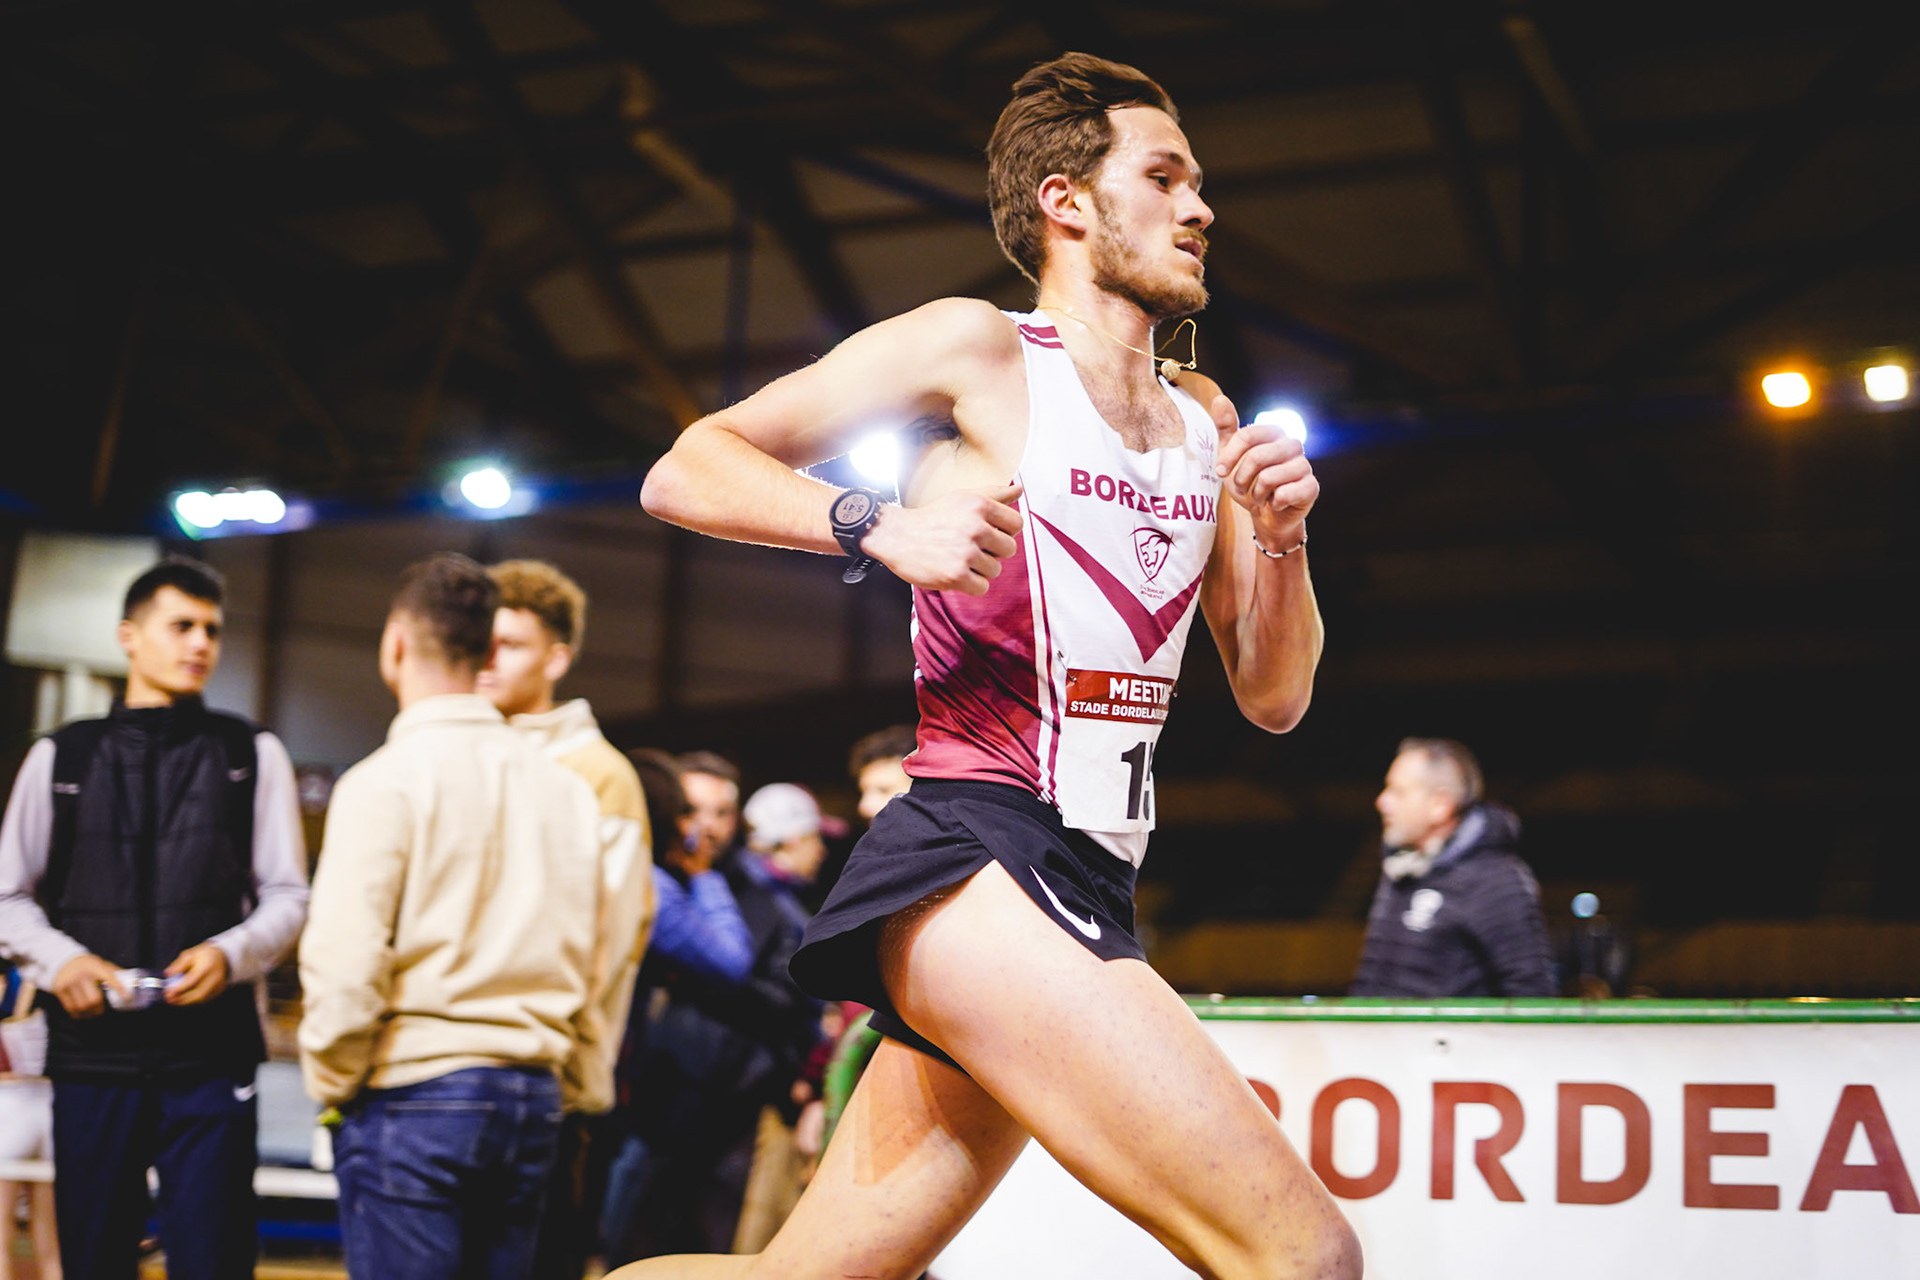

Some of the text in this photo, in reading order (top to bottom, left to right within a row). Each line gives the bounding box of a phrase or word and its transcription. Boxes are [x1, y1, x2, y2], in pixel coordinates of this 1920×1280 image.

[1071, 468, 1216, 523] BORDEAUX
[1070, 701, 1109, 715] STADE
[1109, 677, 1172, 705] MEETI
[1245, 1077, 1920, 1214] ORDEA
